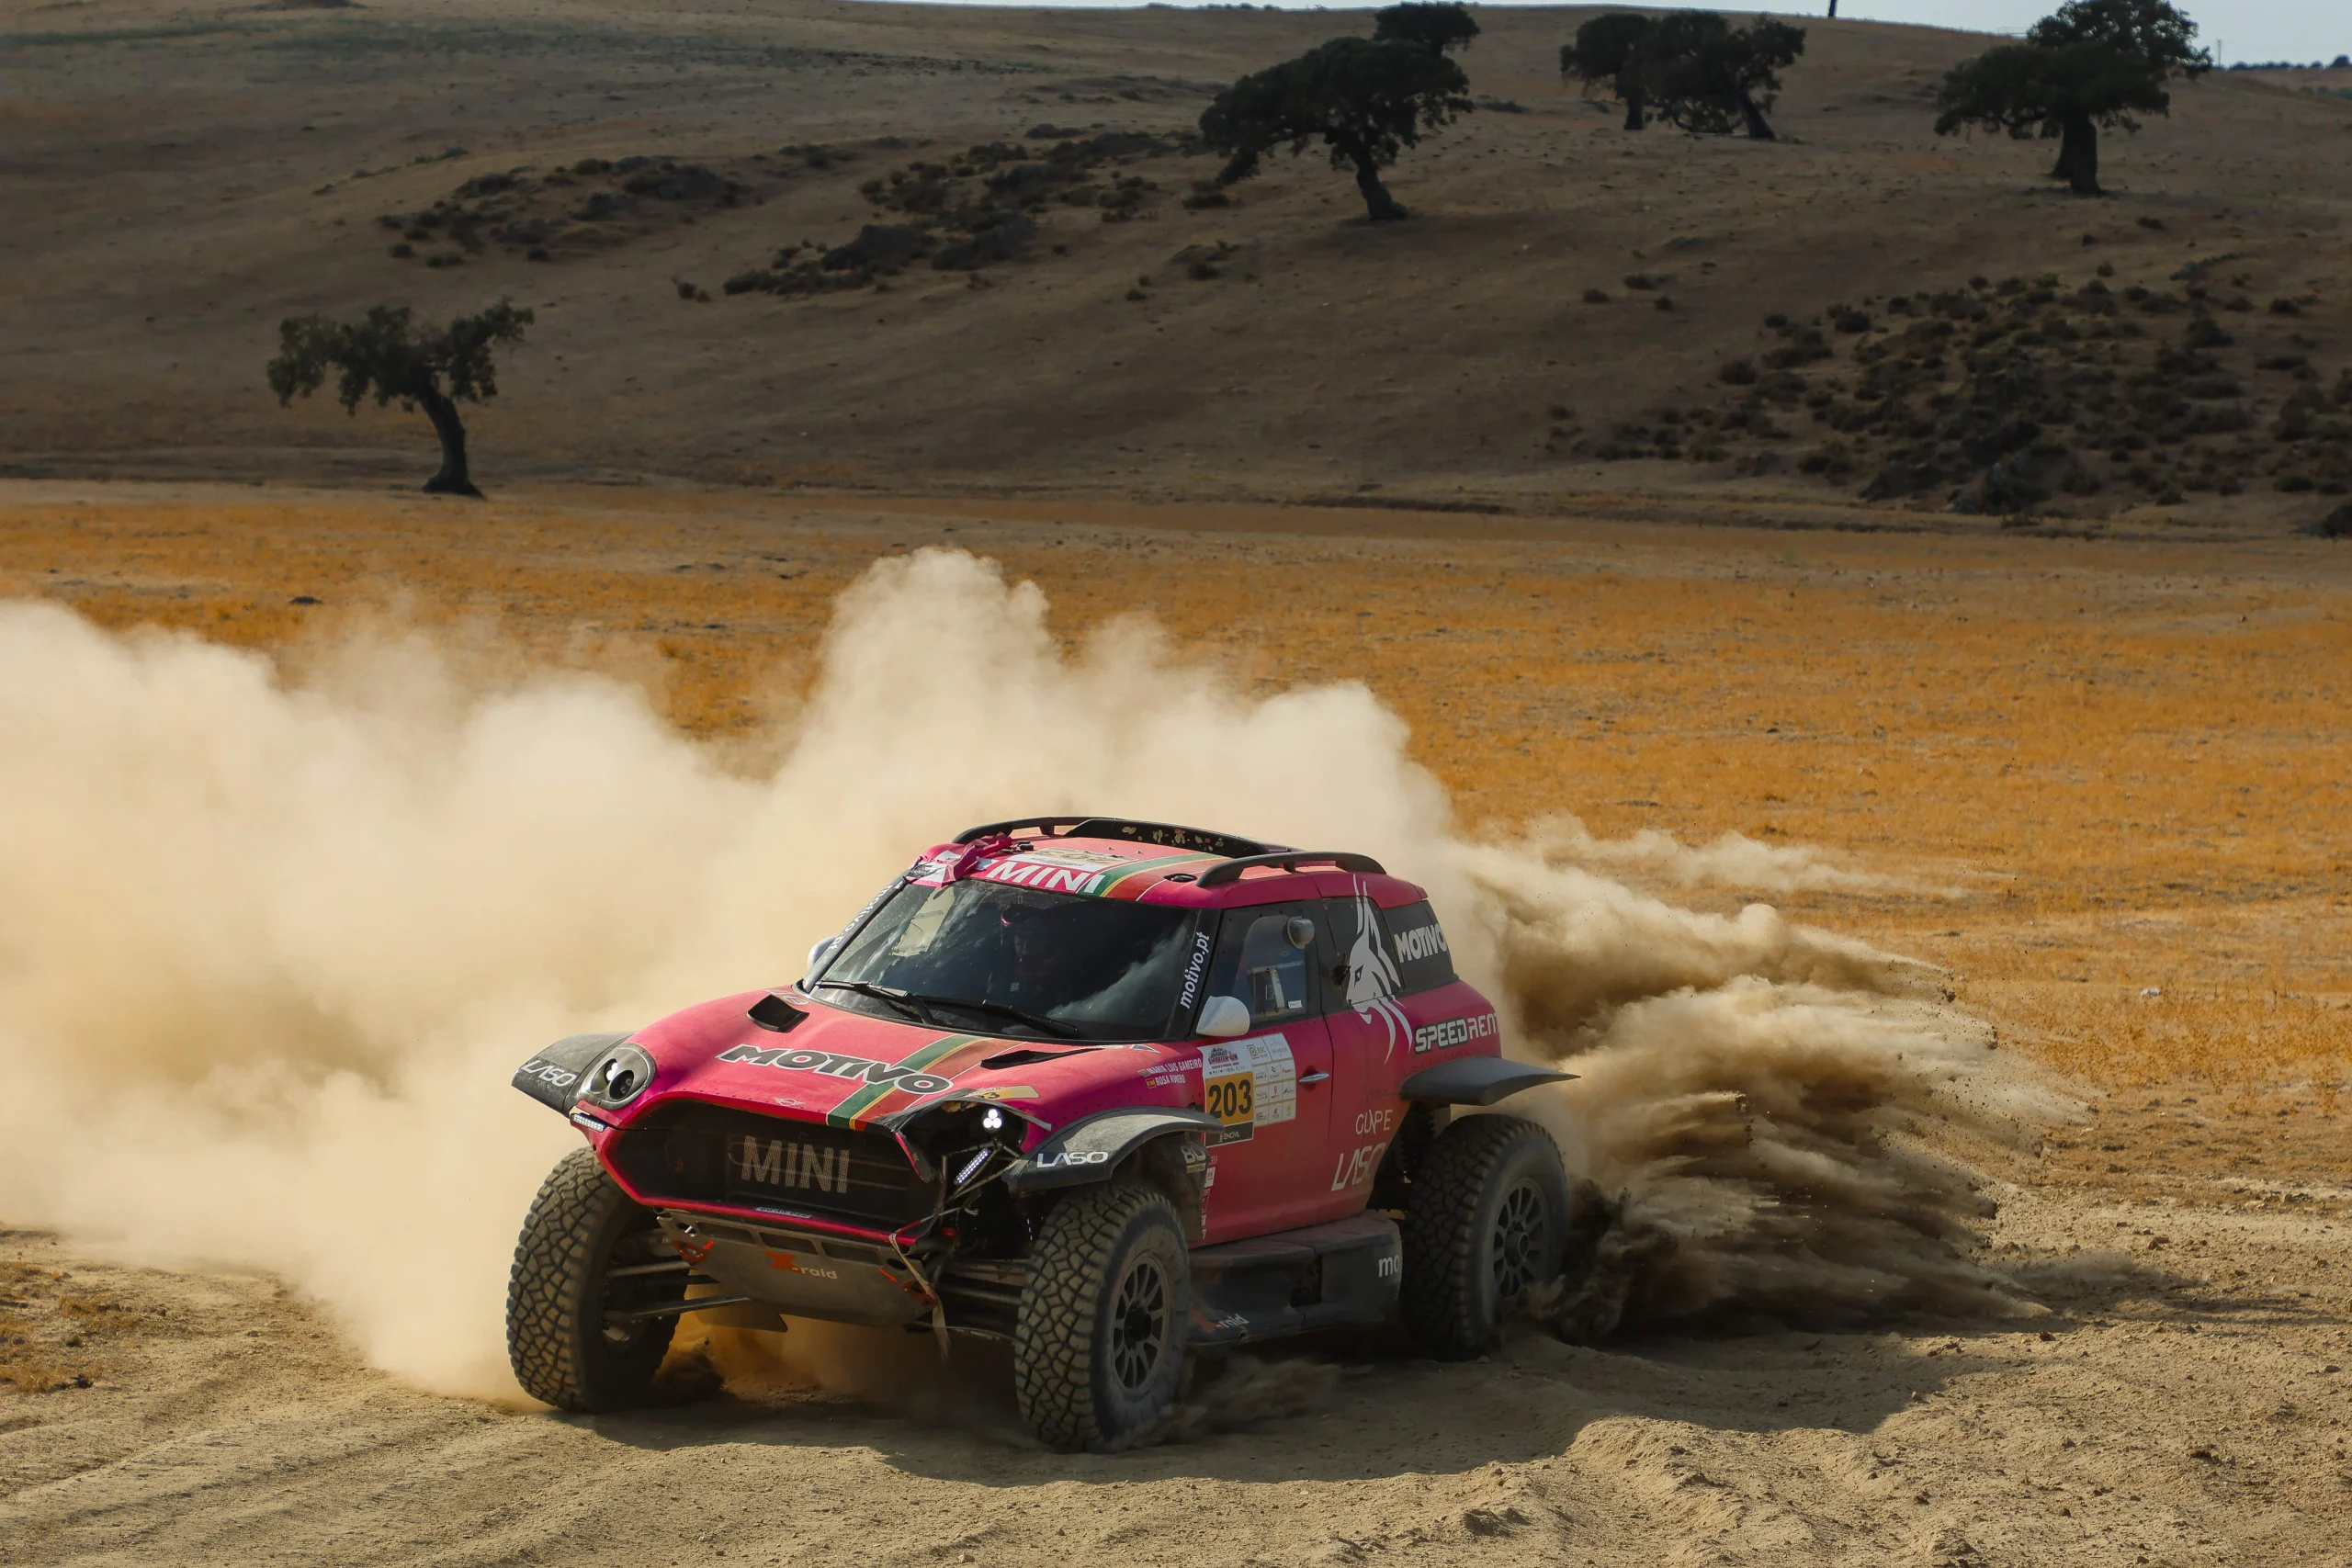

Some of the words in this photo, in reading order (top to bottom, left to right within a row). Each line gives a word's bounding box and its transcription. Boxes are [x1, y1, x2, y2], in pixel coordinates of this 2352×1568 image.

[986, 861, 1105, 893] MINI
[1394, 923, 1447, 964] MOTIVO
[1181, 931, 1210, 1009] motivo.pt
[521, 1060, 577, 1087] LASO
[716, 1043, 954, 1094] MOTIVO
[1146, 1065, 1168, 1075] MARIA
[1165, 1063, 1179, 1073] LUIS
[1178, 1058, 1202, 1071] GAMEIRO
[1155, 1076, 1170, 1086] ROSA
[1208, 1079, 1252, 1118] 203
[741, 1135, 849, 1194] MINI
[1037, 1151, 1108, 1168] LASO
